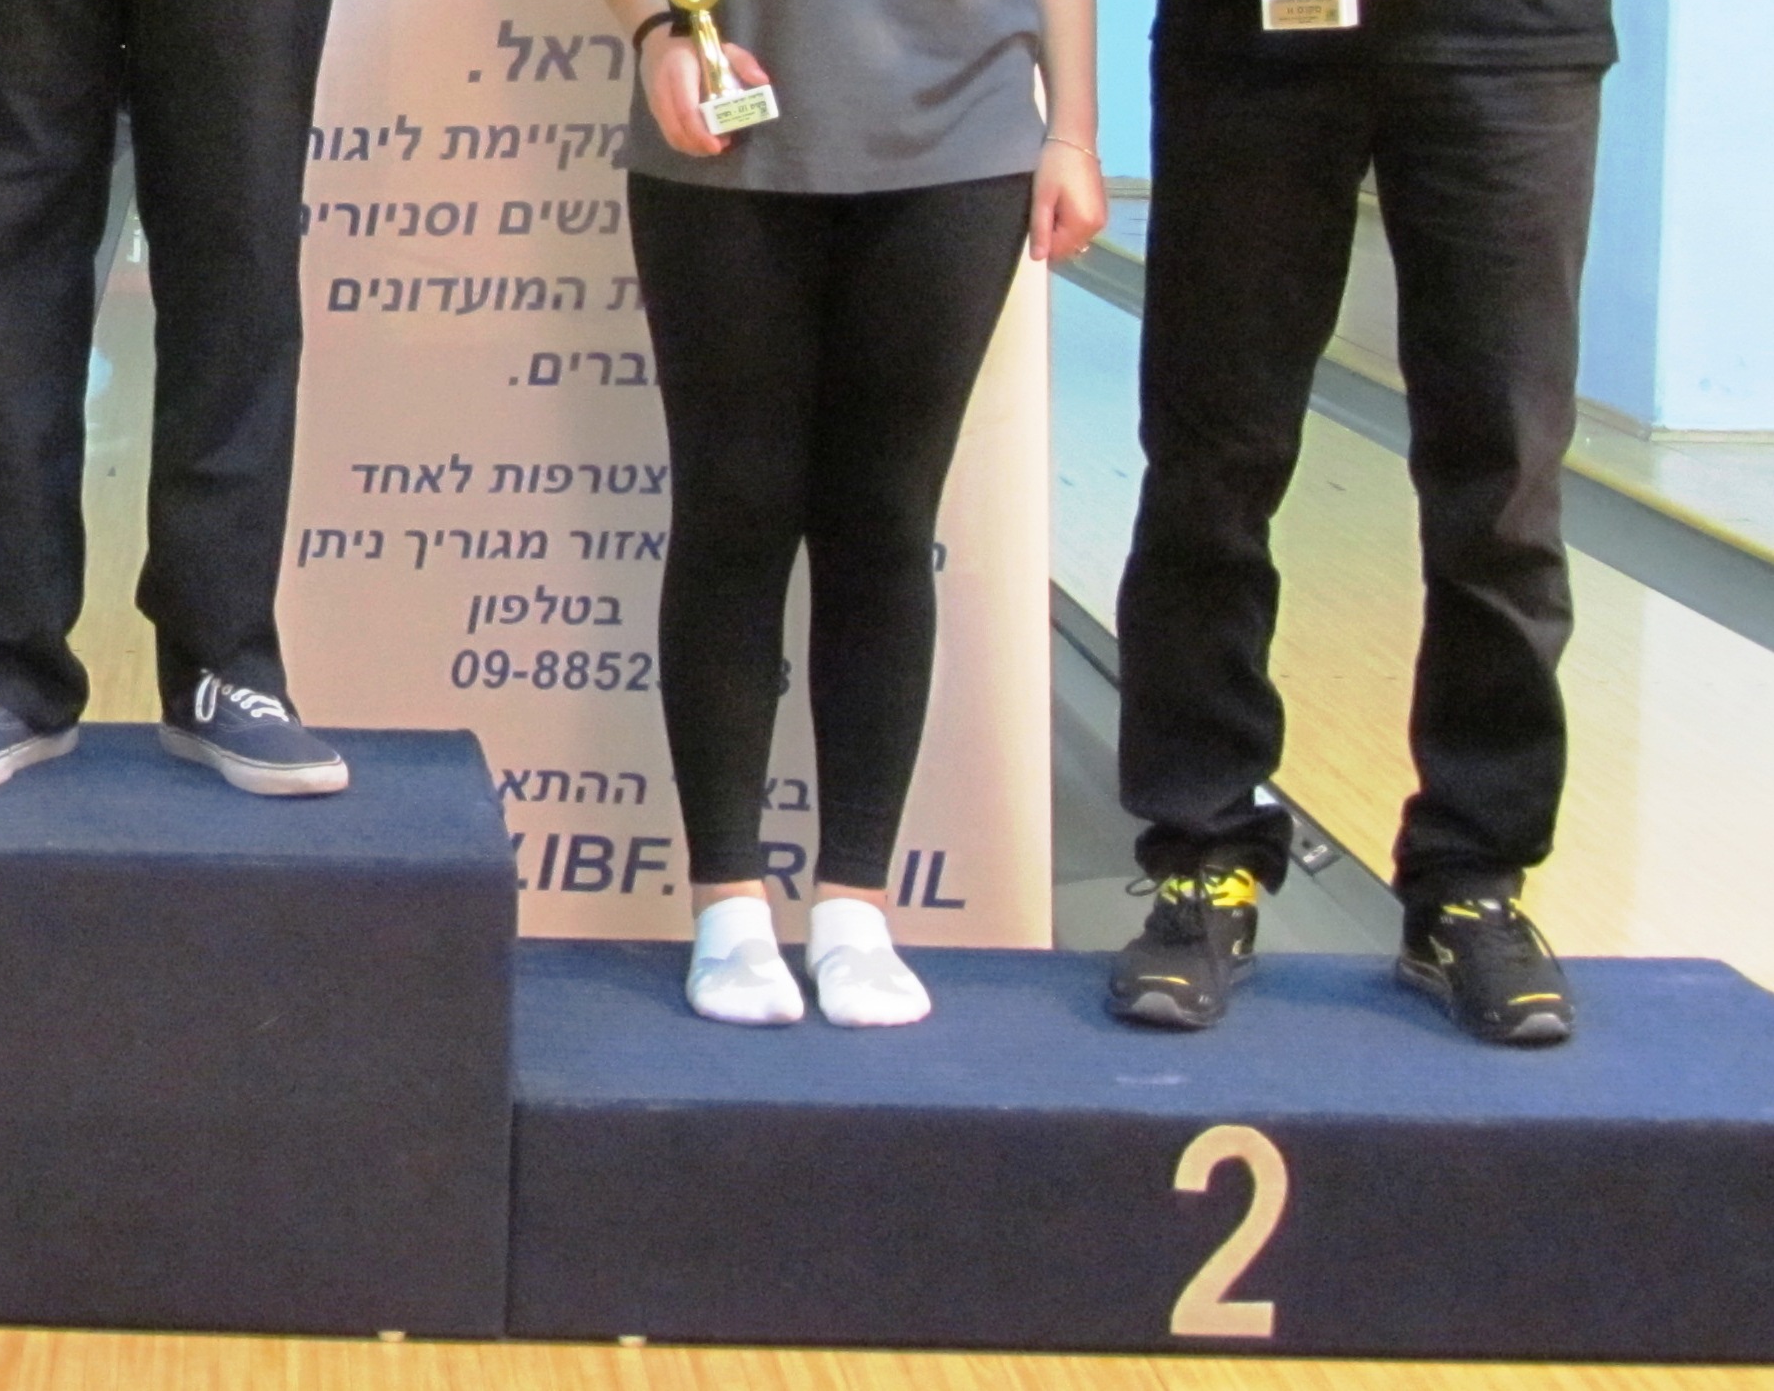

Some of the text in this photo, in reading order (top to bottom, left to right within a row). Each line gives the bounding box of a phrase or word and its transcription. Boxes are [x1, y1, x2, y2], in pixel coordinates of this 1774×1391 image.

[468, 20, 625, 83] ראל.
[327, 275, 587, 316] המועדונים
[508, 351, 659, 386] ברים.
[351, 453, 668, 495] צטרפות לאחד
[297, 528, 385, 568] ניתן
[405, 529, 548, 570] מגוריך
[467, 584, 622, 635] בטלפון
[451, 648, 661, 692] 09-8852
[499, 769, 647, 805] ההתא
[1170, 1124, 1289, 1338] 2
